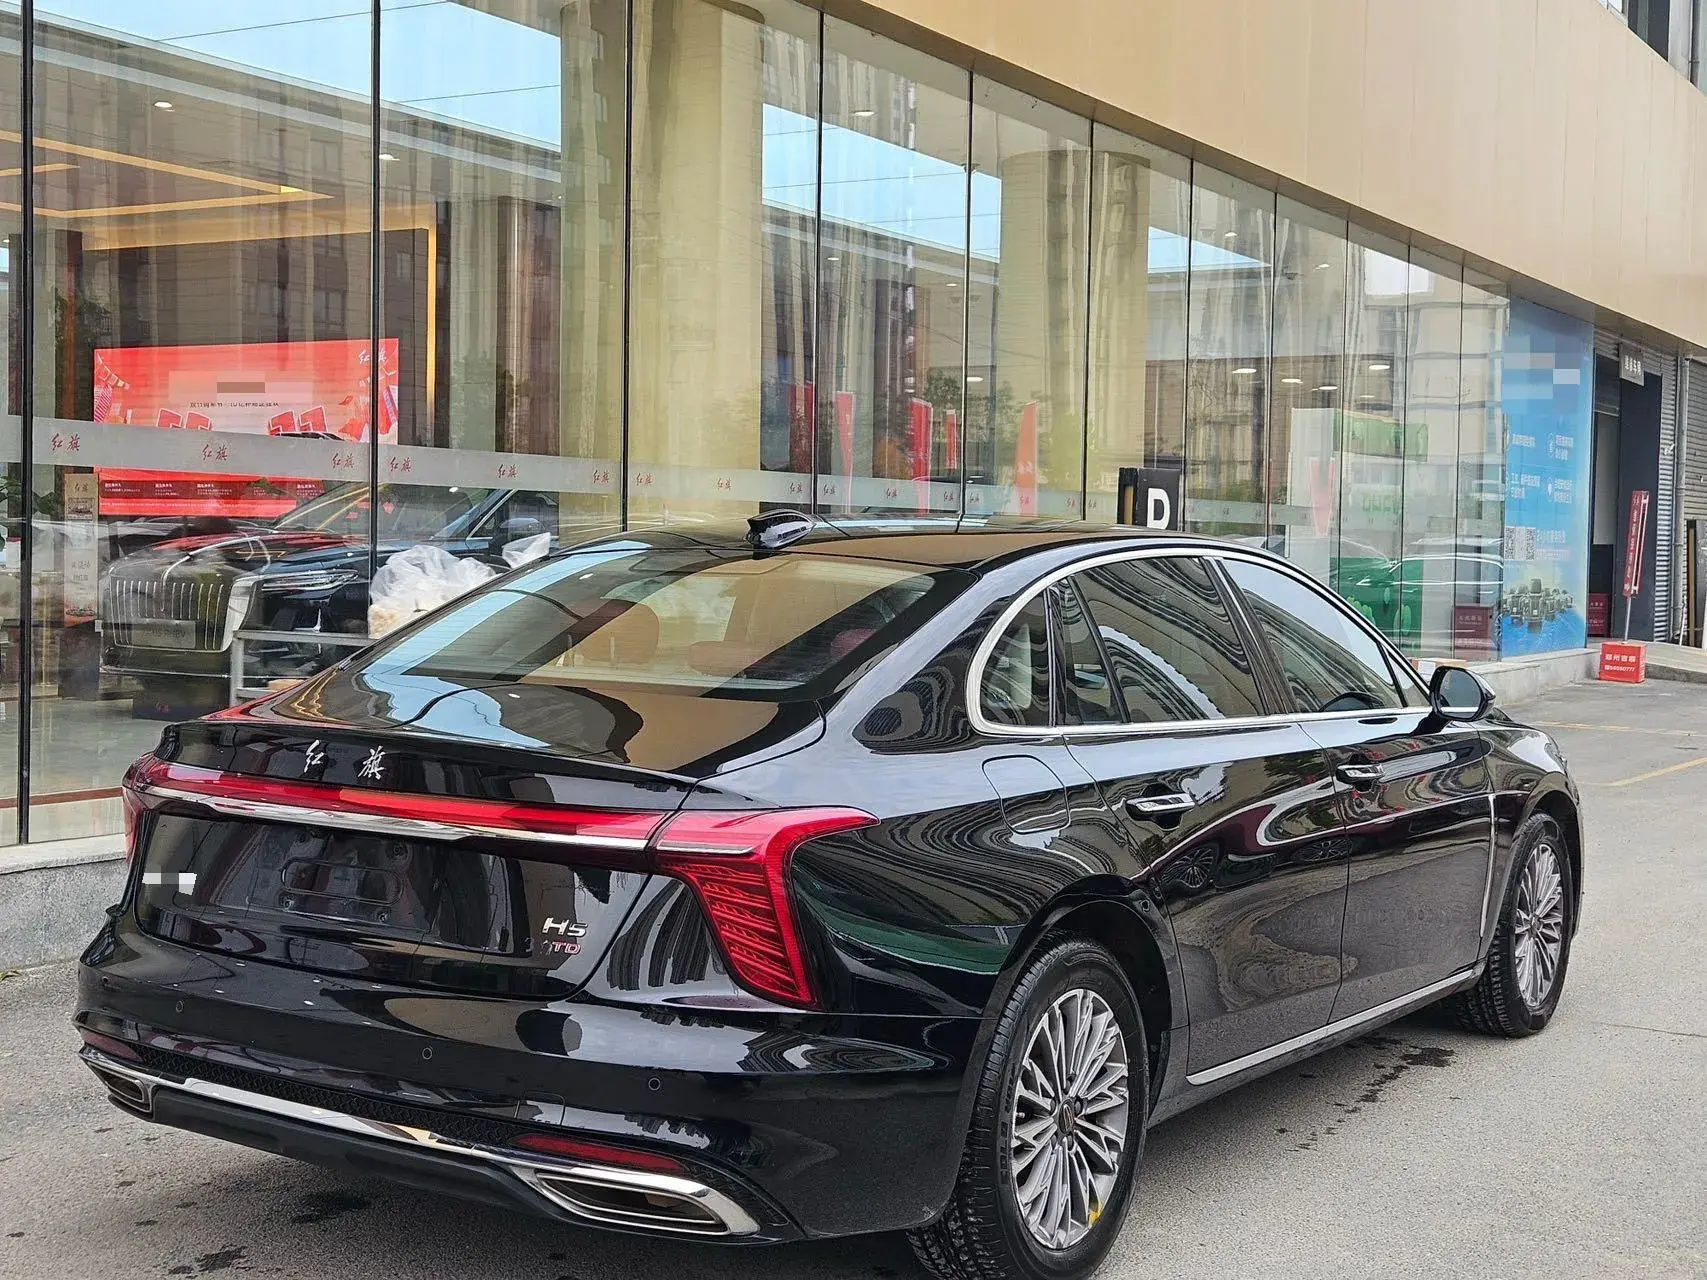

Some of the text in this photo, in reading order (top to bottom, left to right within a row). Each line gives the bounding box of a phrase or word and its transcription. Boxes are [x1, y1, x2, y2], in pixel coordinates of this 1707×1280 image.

[52, 433, 80, 451] 红旗
[202, 444, 227, 461] 红旗
[332, 452, 354, 469] 红旗
[390, 456, 412, 472] 红旗
[498, 464, 518, 478] 红旗
[593, 470, 609, 484] 红旗
[636, 472, 653, 486] 红旗
[1147, 487, 1170, 530] D
[303, 739, 386, 780] 红旗
